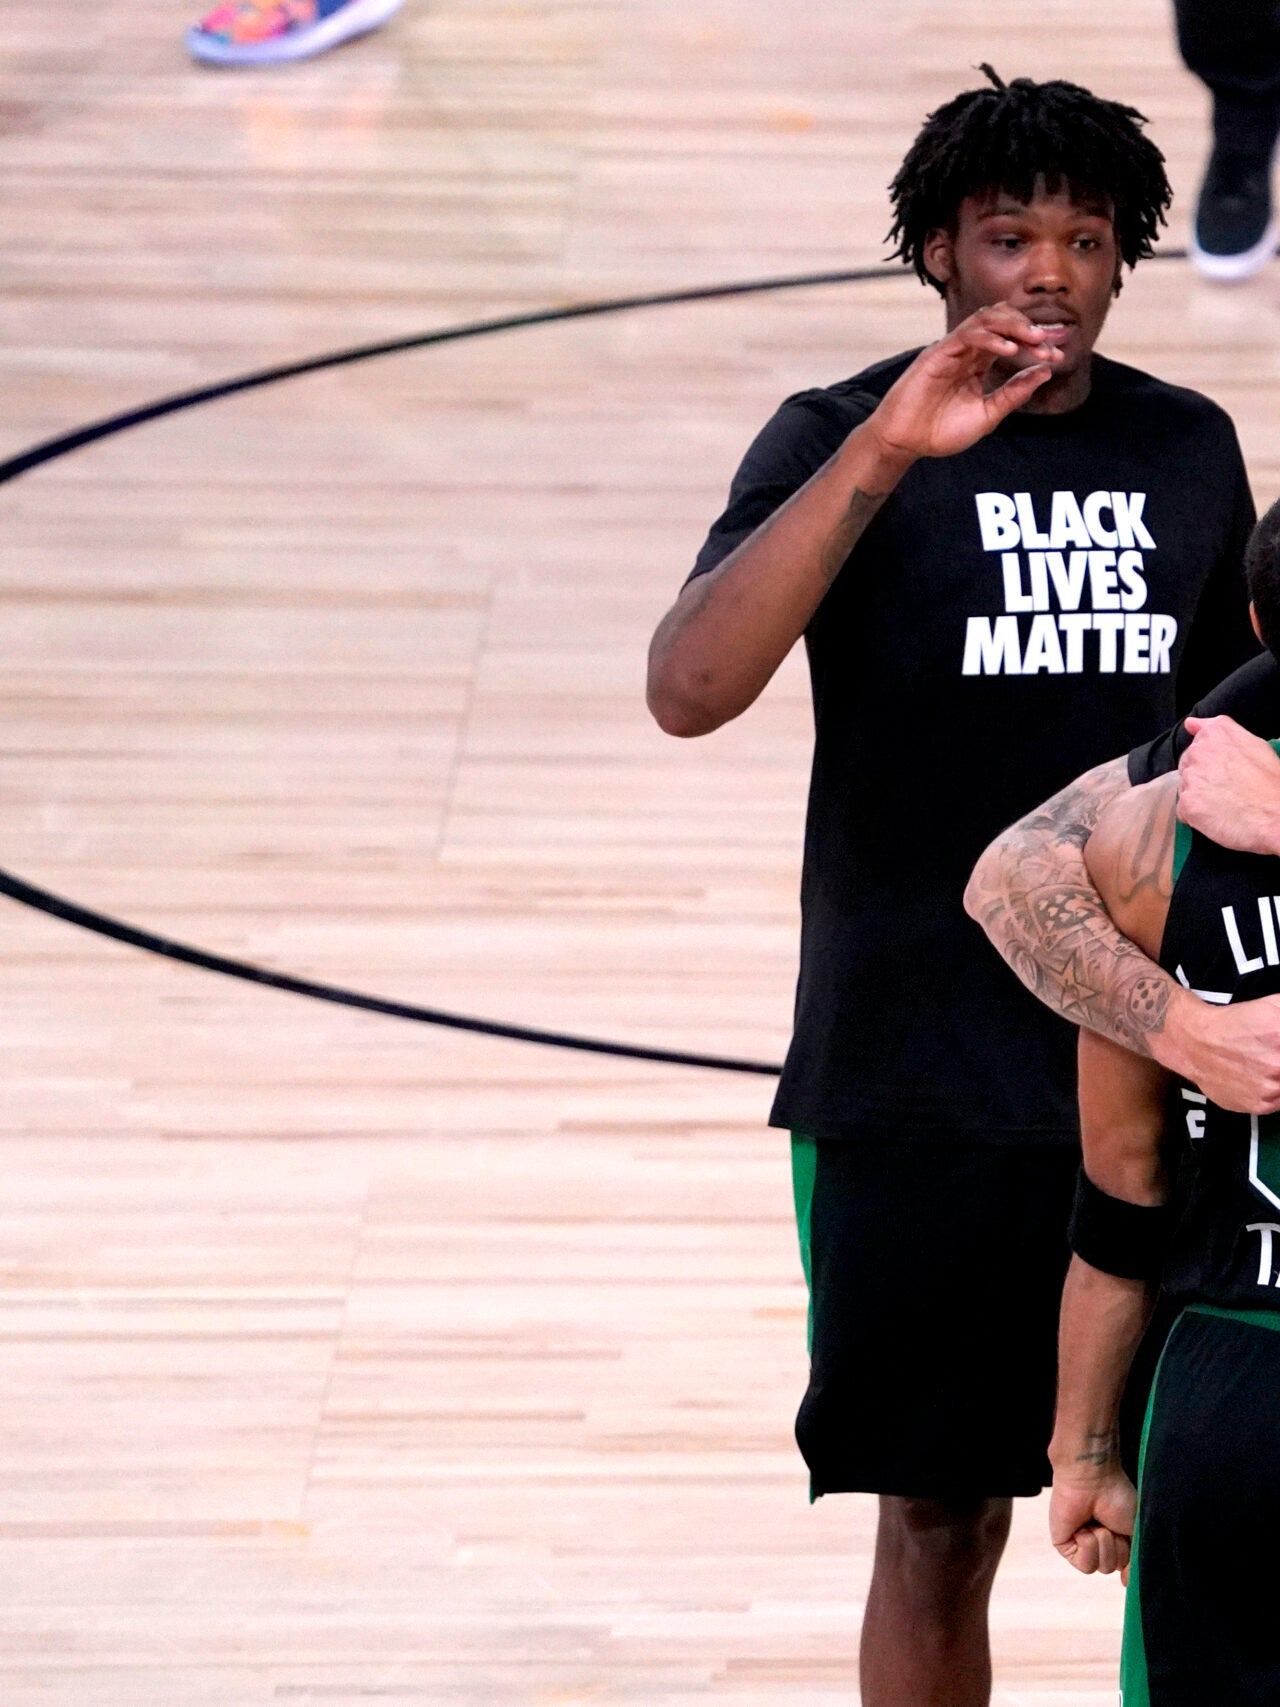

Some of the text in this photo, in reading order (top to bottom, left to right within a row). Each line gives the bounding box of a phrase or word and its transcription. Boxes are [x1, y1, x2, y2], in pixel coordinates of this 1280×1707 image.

[975, 491, 1157, 551] BLACK
[1001, 550, 1148, 613] LIVES
[962, 613, 1178, 676] MATTER
